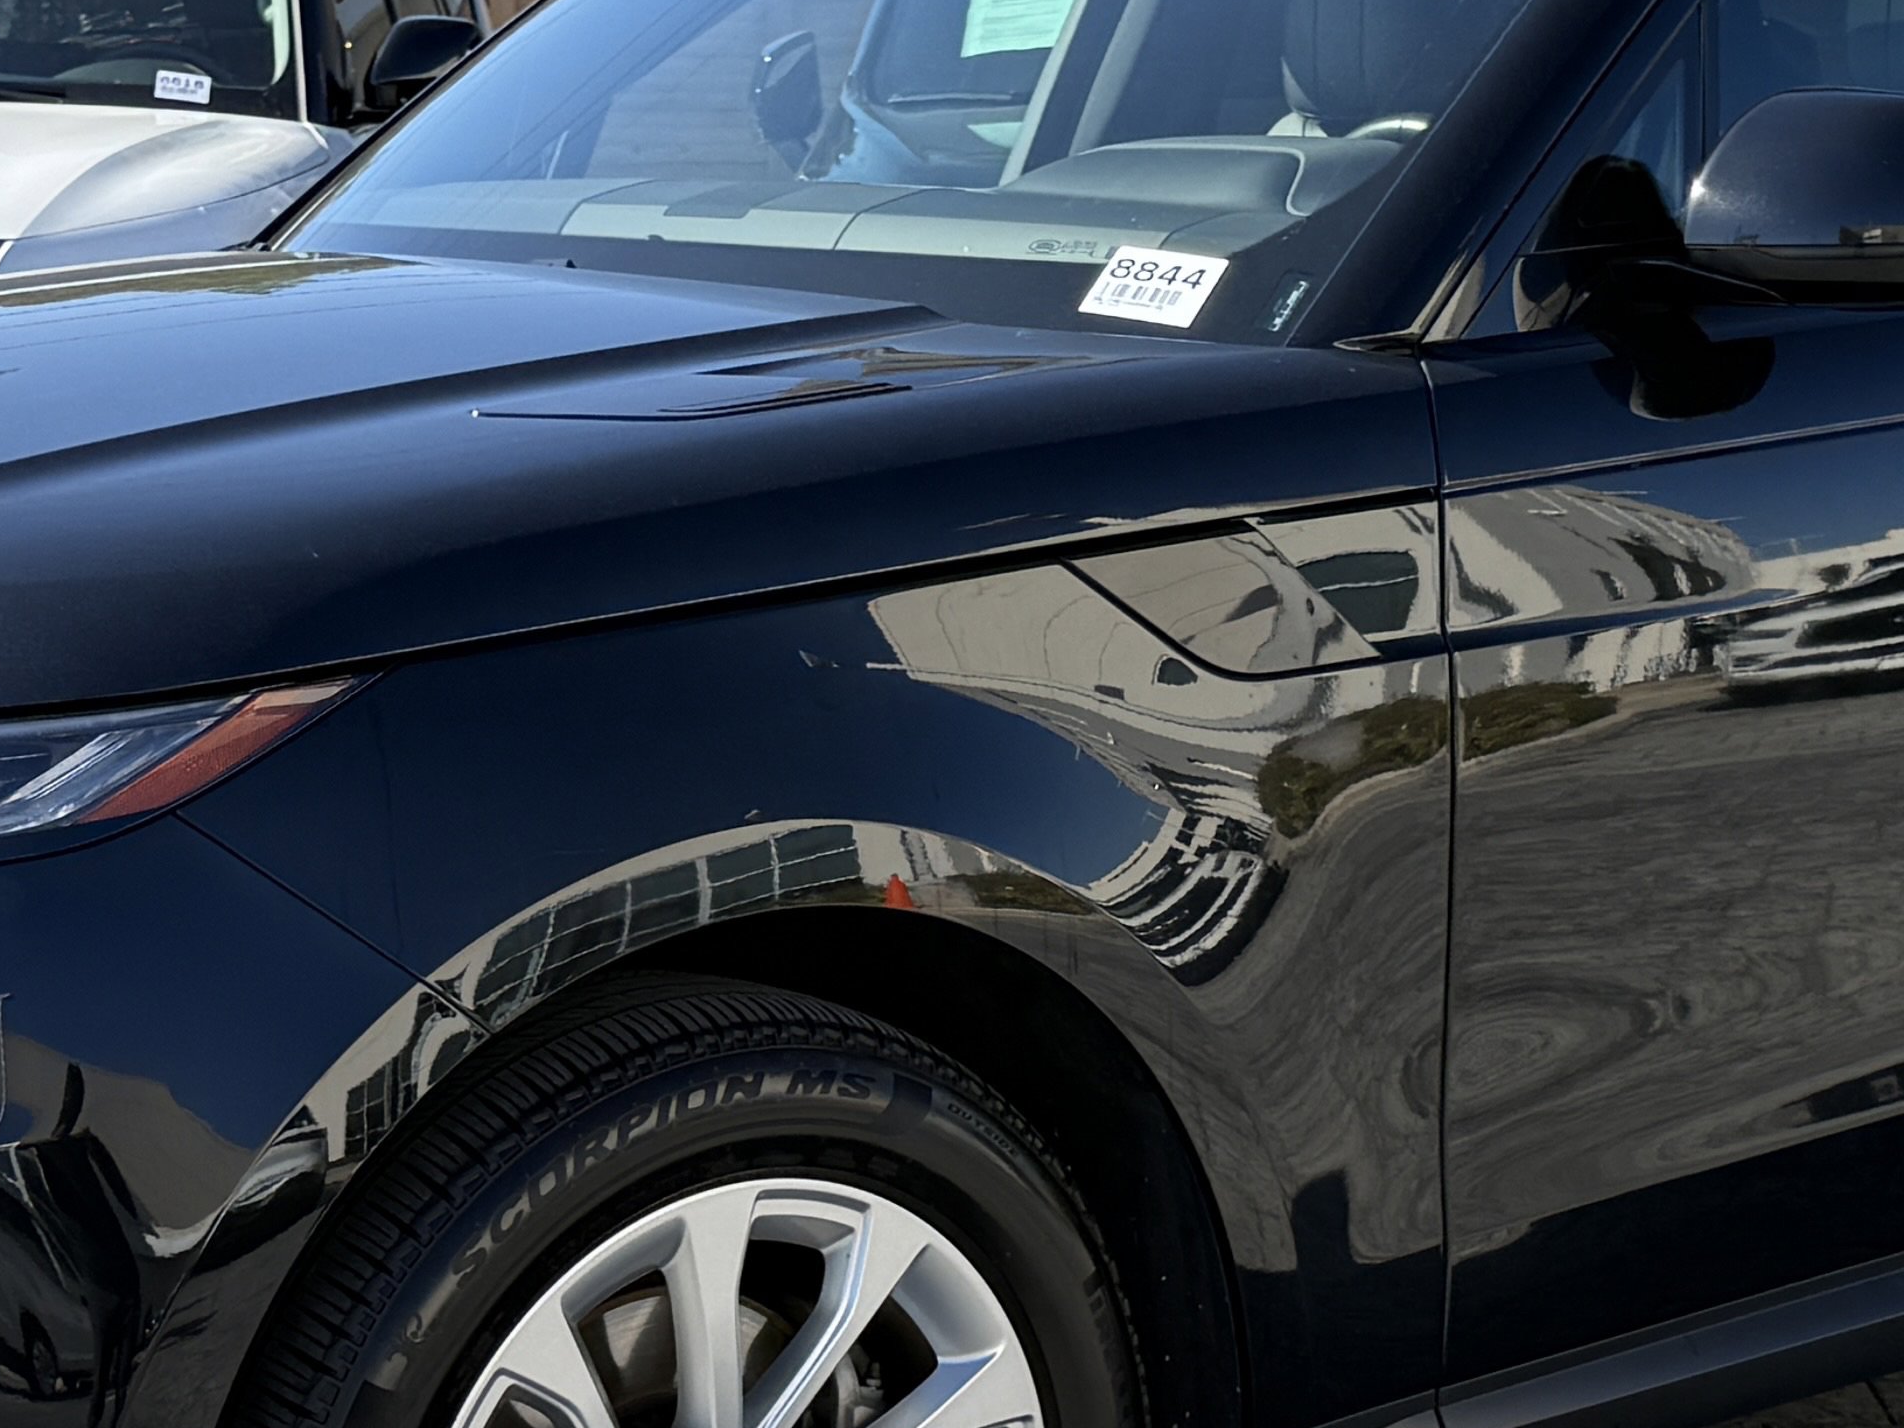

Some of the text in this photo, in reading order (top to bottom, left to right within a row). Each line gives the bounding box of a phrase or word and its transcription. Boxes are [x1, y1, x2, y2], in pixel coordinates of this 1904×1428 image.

[1109, 258, 1207, 290] 8844
[451, 1068, 878, 1290] SCORPION MS
